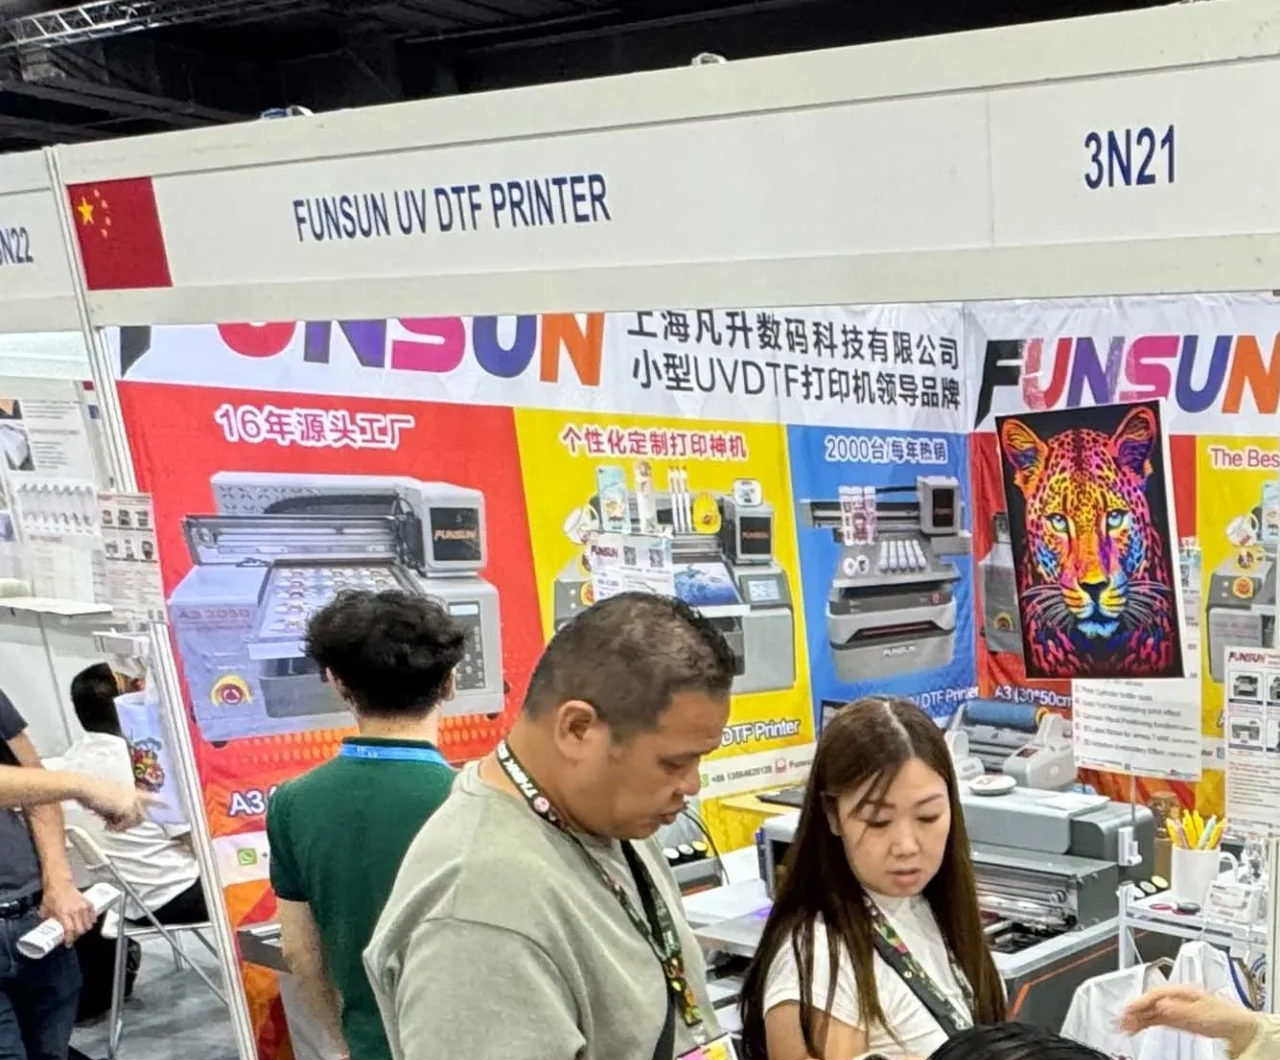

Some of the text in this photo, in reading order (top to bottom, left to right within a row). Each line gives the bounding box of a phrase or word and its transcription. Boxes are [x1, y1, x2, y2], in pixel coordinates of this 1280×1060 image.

[1084, 125, 1176, 189] 3N21
[293, 173, 612, 242] FUNSUN UV DTF PRINTER
[627, 309, 961, 371] 上海凡升数码科技有限公司
[632, 348, 961, 411] 小型UVDTF打印机领导品牌
[217, 406, 414, 449] 16年源头工厂
[562, 426, 748, 459] 个性化定制打印神机
[1211, 448, 1280, 468] The Bes
[1228, 652, 1267, 664] FUNSUN
[922, 689, 944, 708] DTF
[995, 685, 1012, 699] A3
[722, 719, 800, 745] DTF Printer
[229, 789, 265, 816] A3
